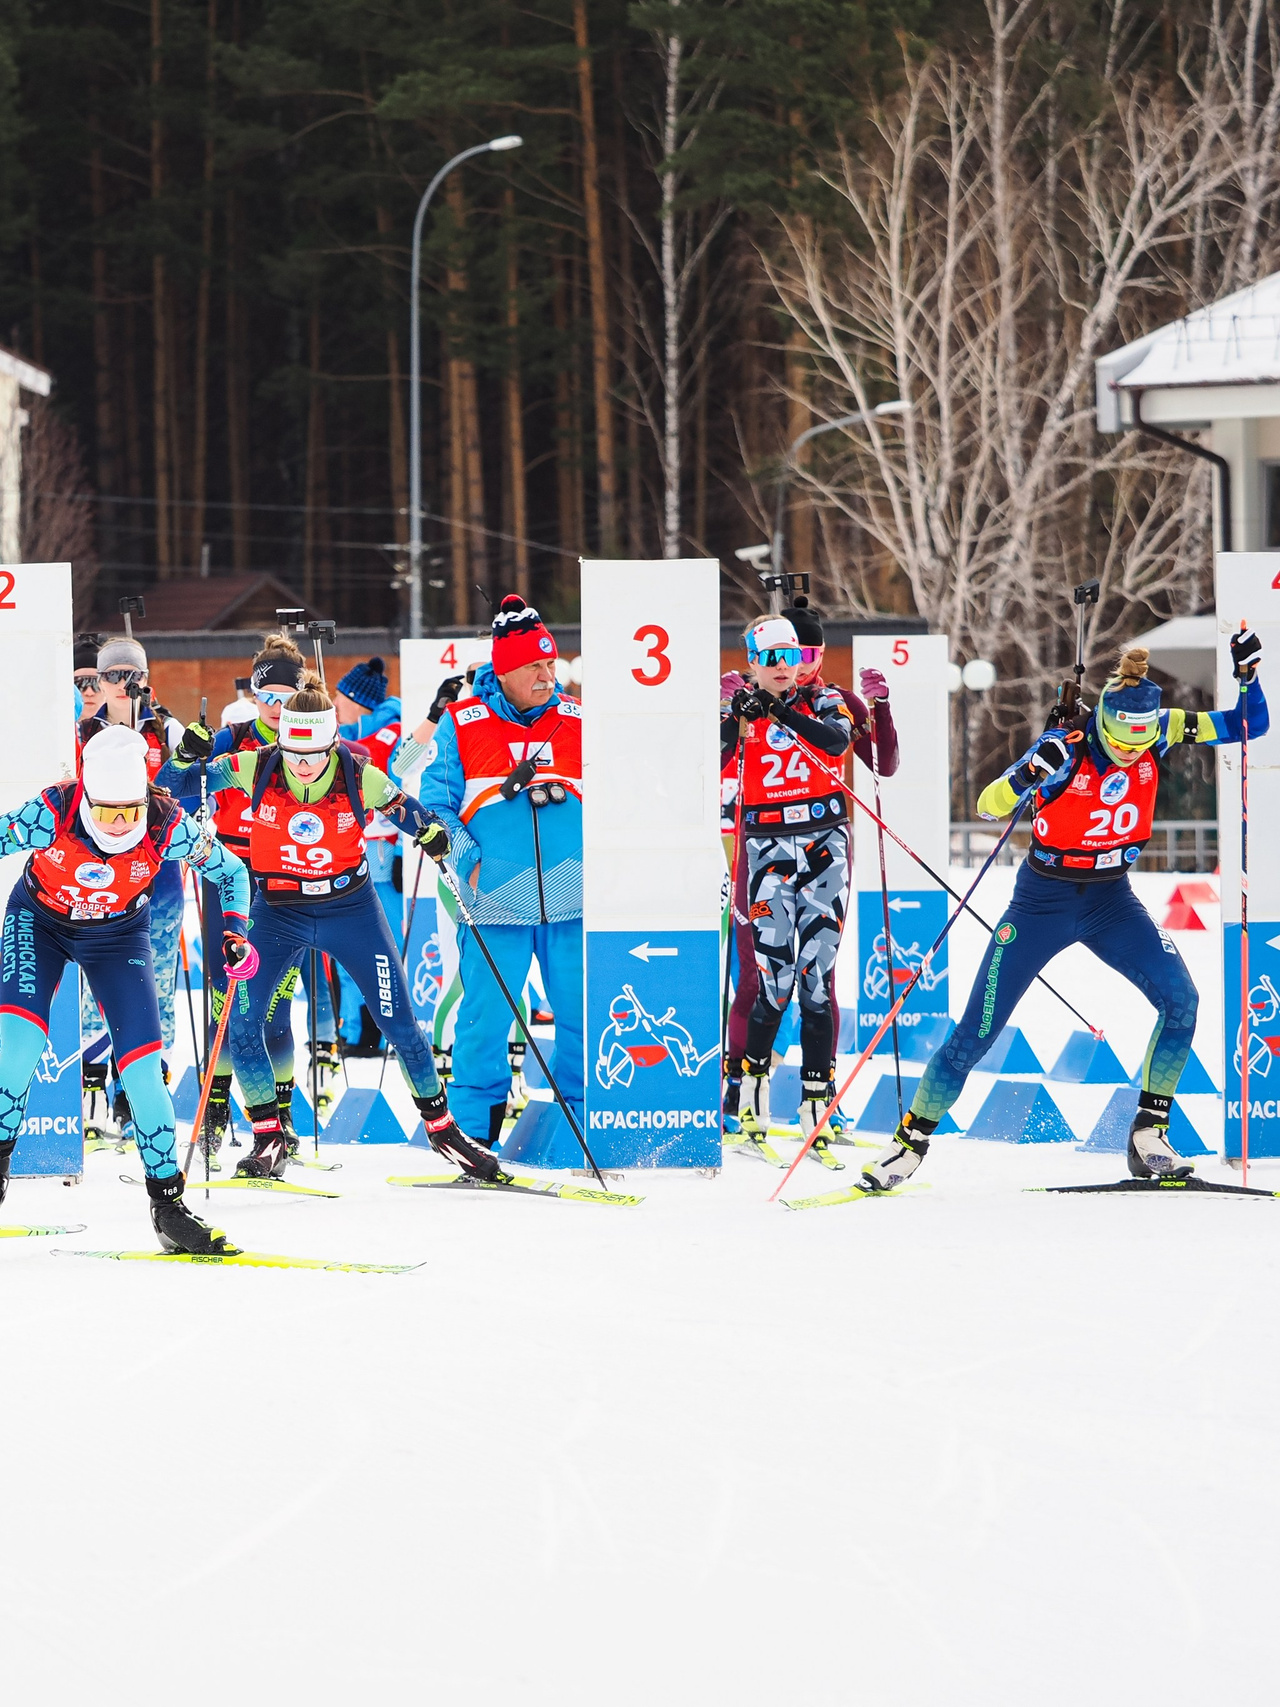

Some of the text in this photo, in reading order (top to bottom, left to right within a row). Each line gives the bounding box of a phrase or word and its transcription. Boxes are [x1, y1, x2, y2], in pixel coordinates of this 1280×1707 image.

[440, 643, 458, 669] 4
[631, 624, 672, 687] 3
[891, 640, 910, 666] 5
[462, 707, 482, 721] 35
[760, 751, 811, 788] 24
[1083, 803, 1139, 837] 20
[279, 844, 333, 869] 19
[55, 890, 112, 912] КРАСНОЯРСК
[2, 914, 16, 984] ОБЛАСТЬ
[1153, 1098, 1169, 1107] 170
[1228, 1100, 1280, 1120] КРАС
[589, 1109, 718, 1129] КРАСНОЯРСК
[162, 1186, 178, 1196] 168
[247, 1180, 273, 1189] FISCHER
[1159, 1180, 1187, 1188] FISCHER
[572, 1189, 625, 1203] FISCHER
[191, 1256, 224, 1264] FISCHER
